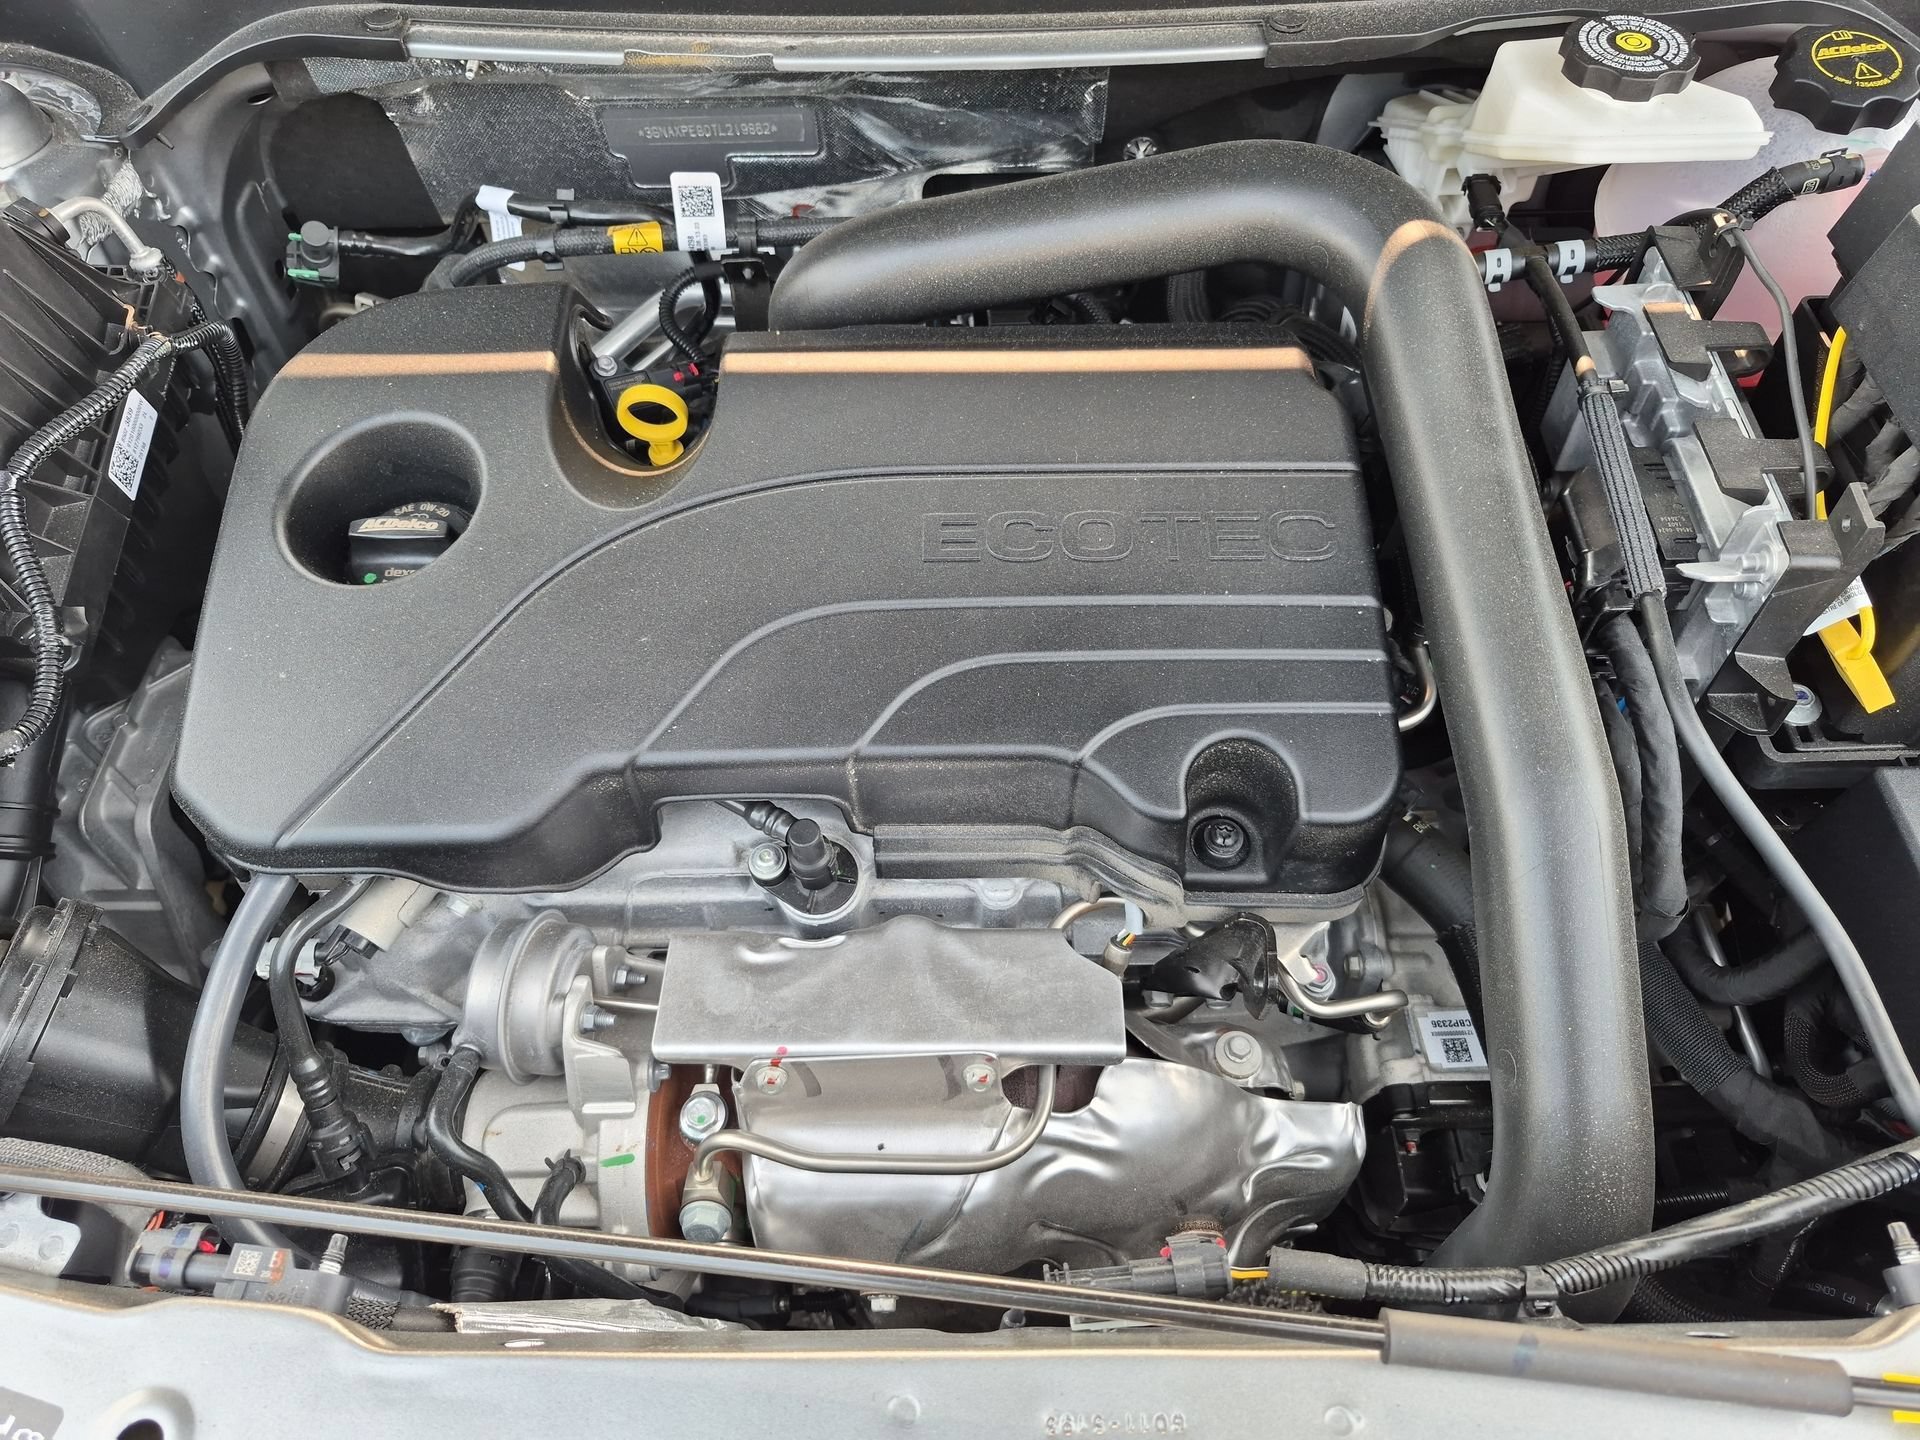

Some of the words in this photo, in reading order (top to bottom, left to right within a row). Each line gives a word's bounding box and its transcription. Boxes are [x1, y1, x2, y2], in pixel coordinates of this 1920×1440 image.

[1817, 43, 1888, 57] ACDelco
[393, 504, 415, 516] SAE
[360, 518, 439, 529] ACDelco
[920, 508, 1340, 562] ECOTEC
[1431, 1018, 1472, 1028] CBP2336
